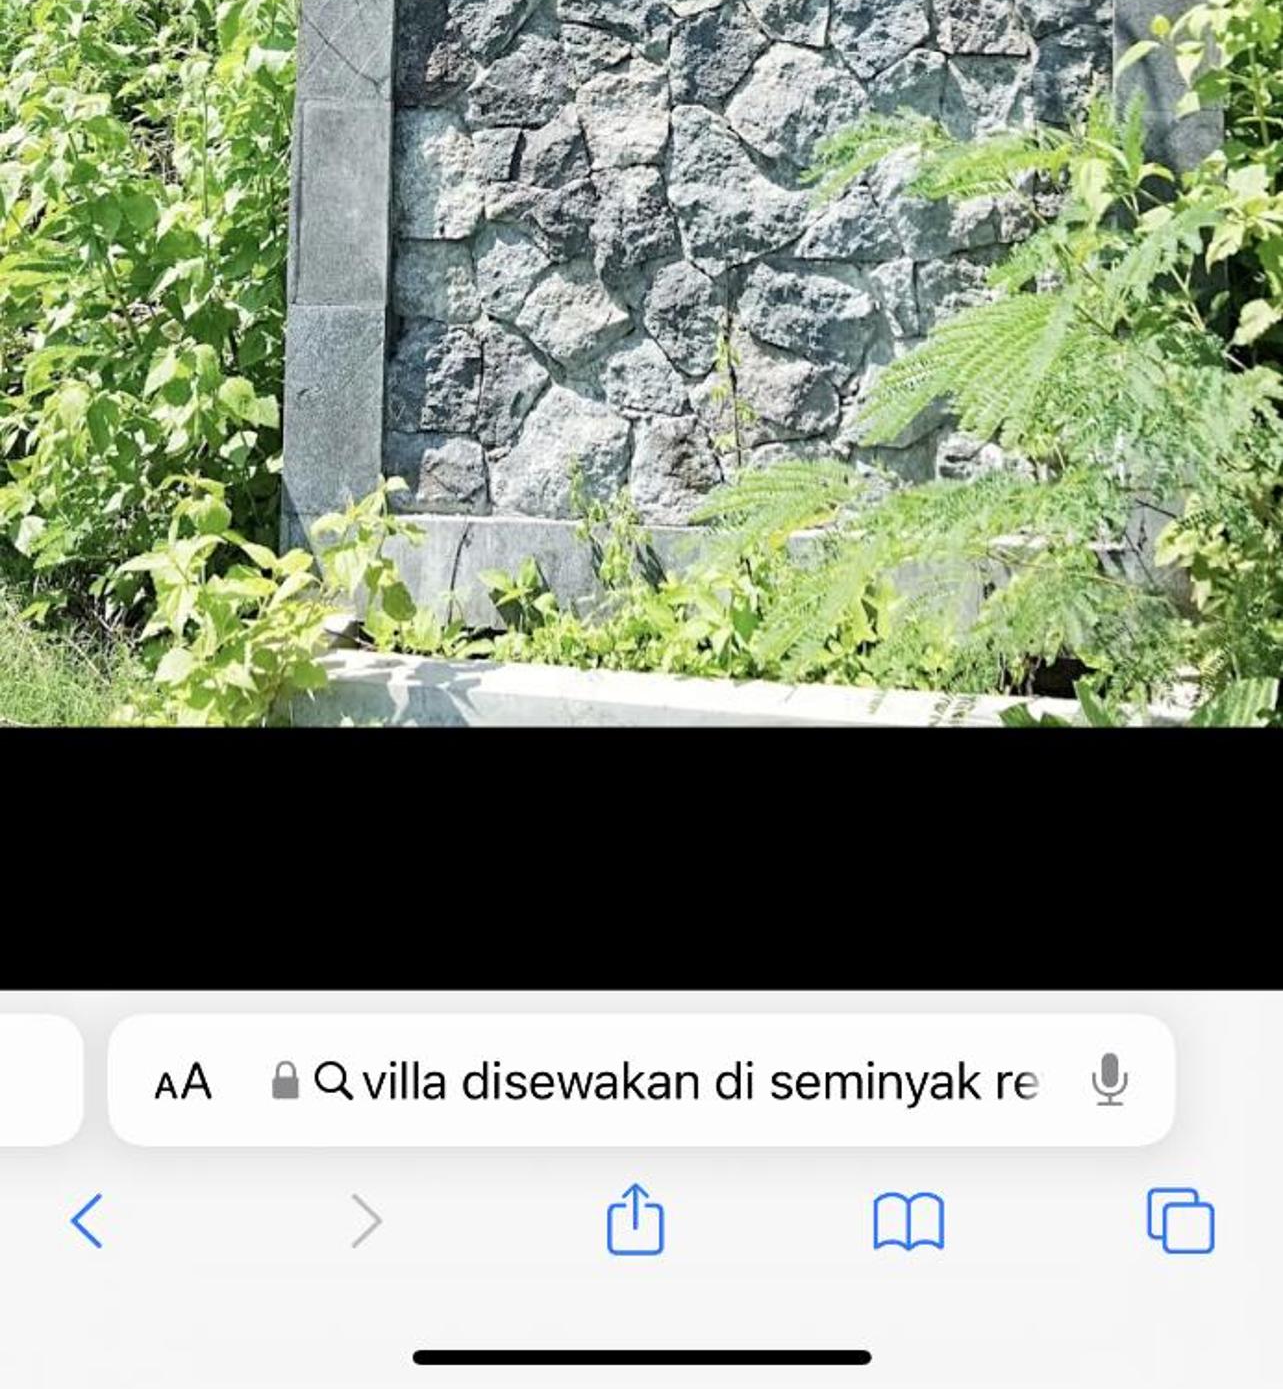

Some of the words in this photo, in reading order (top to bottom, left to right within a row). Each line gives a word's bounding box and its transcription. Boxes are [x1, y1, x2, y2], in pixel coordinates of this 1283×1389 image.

[362, 1060, 446, 1101] villa
[462, 1060, 699, 1101] disewakan
[716, 1060, 754, 1101] di
[770, 1060, 982, 1110] seminyak
[997, 1071, 1040, 1101] re
